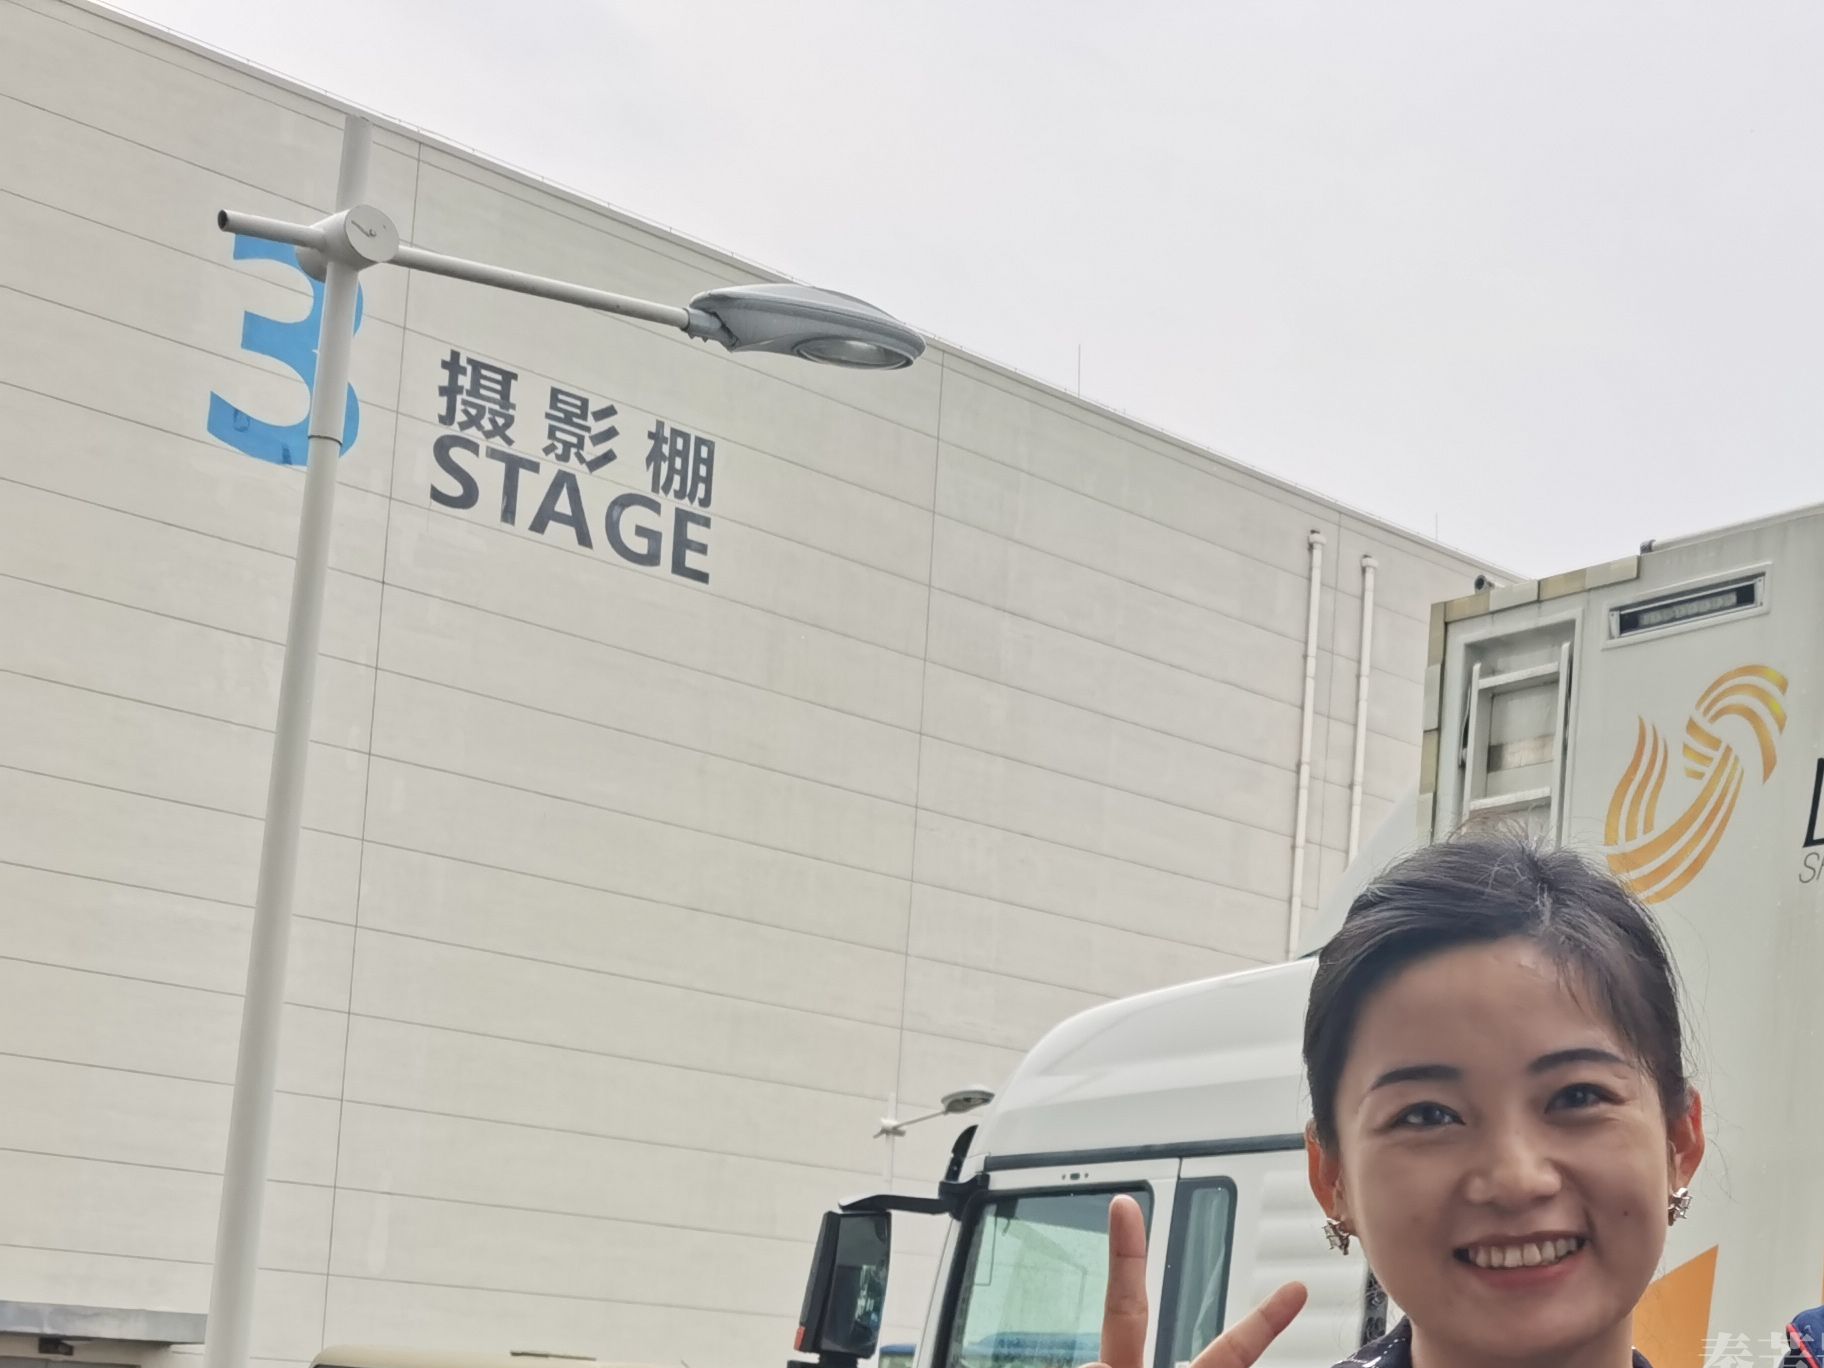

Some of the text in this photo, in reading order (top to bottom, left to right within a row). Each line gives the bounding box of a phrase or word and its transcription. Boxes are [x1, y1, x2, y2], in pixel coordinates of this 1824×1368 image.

[207, 233, 363, 470] 3
[437, 349, 716, 508] 摄影棚
[430, 434, 712, 585] STAGE
